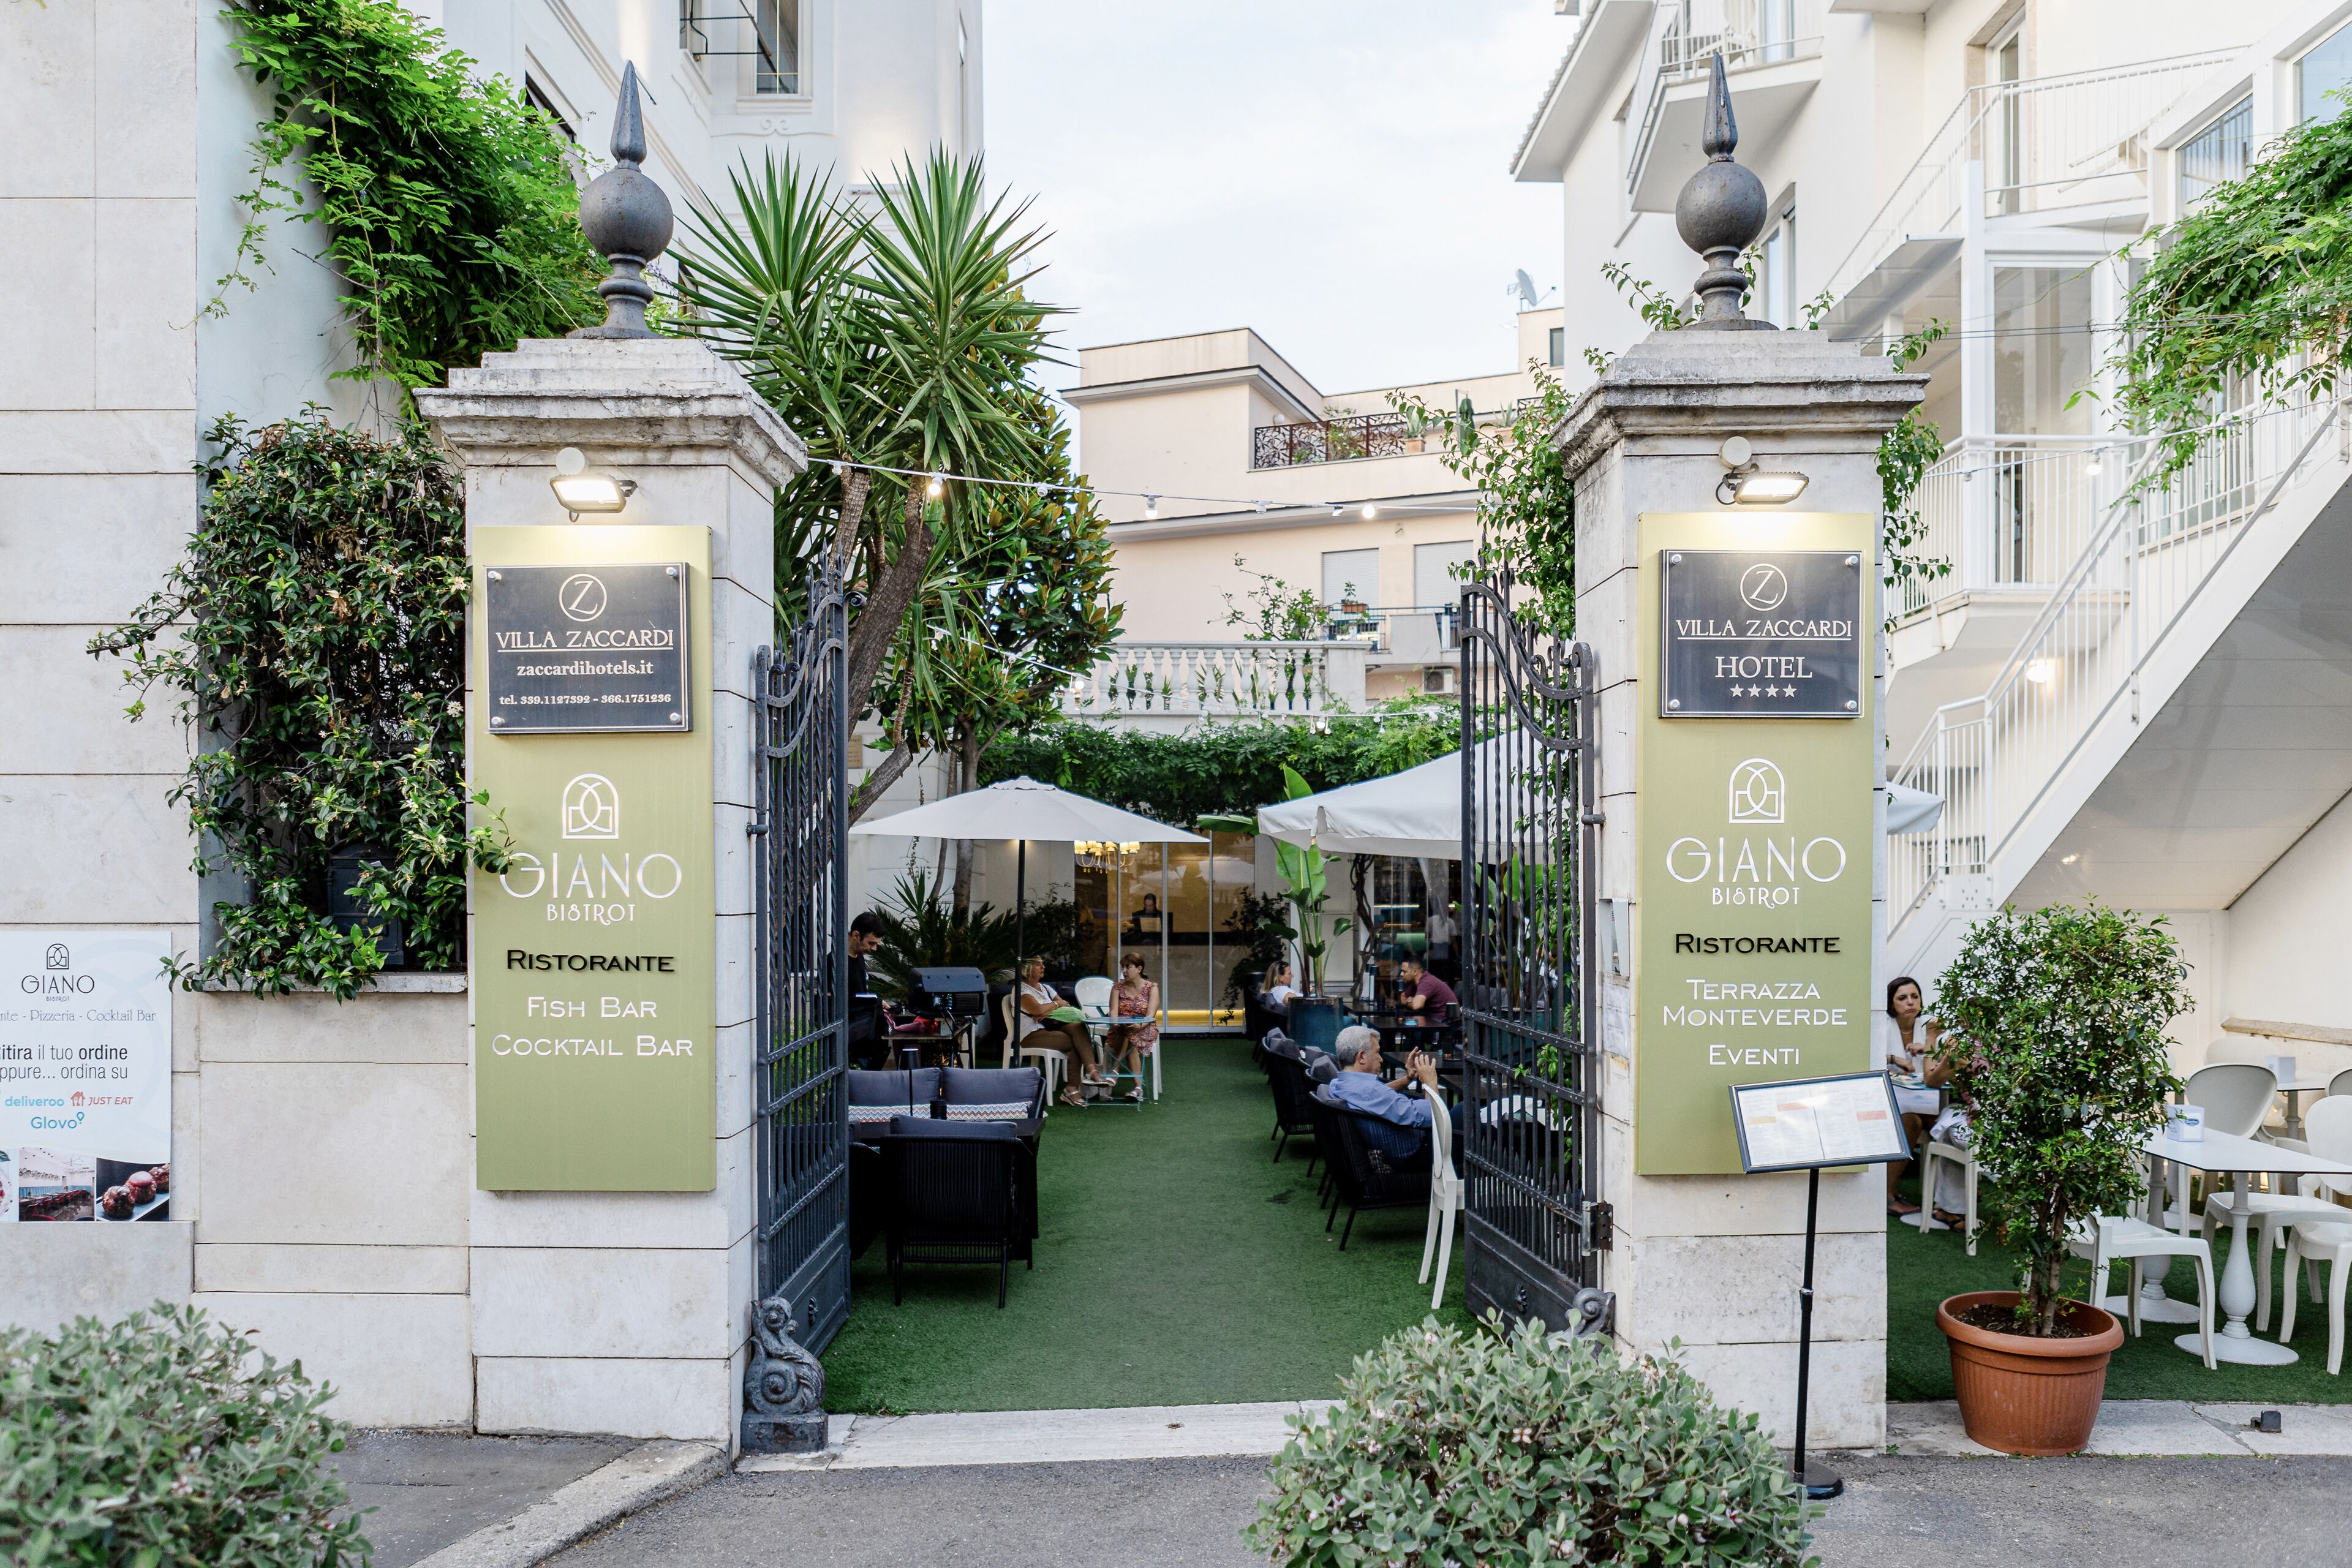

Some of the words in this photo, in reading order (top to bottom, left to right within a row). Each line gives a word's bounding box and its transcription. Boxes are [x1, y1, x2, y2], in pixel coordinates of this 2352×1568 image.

[1676, 620, 1737, 637] VILLA
[1746, 620, 1852, 637] ZACCARDI
[495, 631, 557, 649] VILLA
[565, 629, 674, 647] ZACCARDI
[516, 660, 654, 676] zaccardihotels.it
[1715, 656, 1813, 679] HOTEL
[499, 695, 518, 705] tel.
[1665, 836, 1847, 883] GIANO
[499, 852, 682, 899] GIANO
[1711, 886, 1800, 909] BISTROT
[546, 903, 636, 926] BISTROT
[21, 974, 95, 993] GIANO
[30, 1009, 75, 1021] Pizzeria
[87, 1009, 132, 1022] Cocktail
[137, 1009, 157, 1021] Bar
[0, 1044, 32, 1060] itira
[39, 1044, 45, 1060] il
[50, 1045, 74, 1060] tuo
[78, 1044, 128, 1060] ordine
[61, 1063, 106, 1079] ordina
[111, 1066, 128, 1079] su
[5, 1095, 64, 1107] deliveroo
[88, 1096, 112, 1106] JUST
[114, 1096, 134, 1105] EAT
[31, 1116, 77, 1129] Glovo
